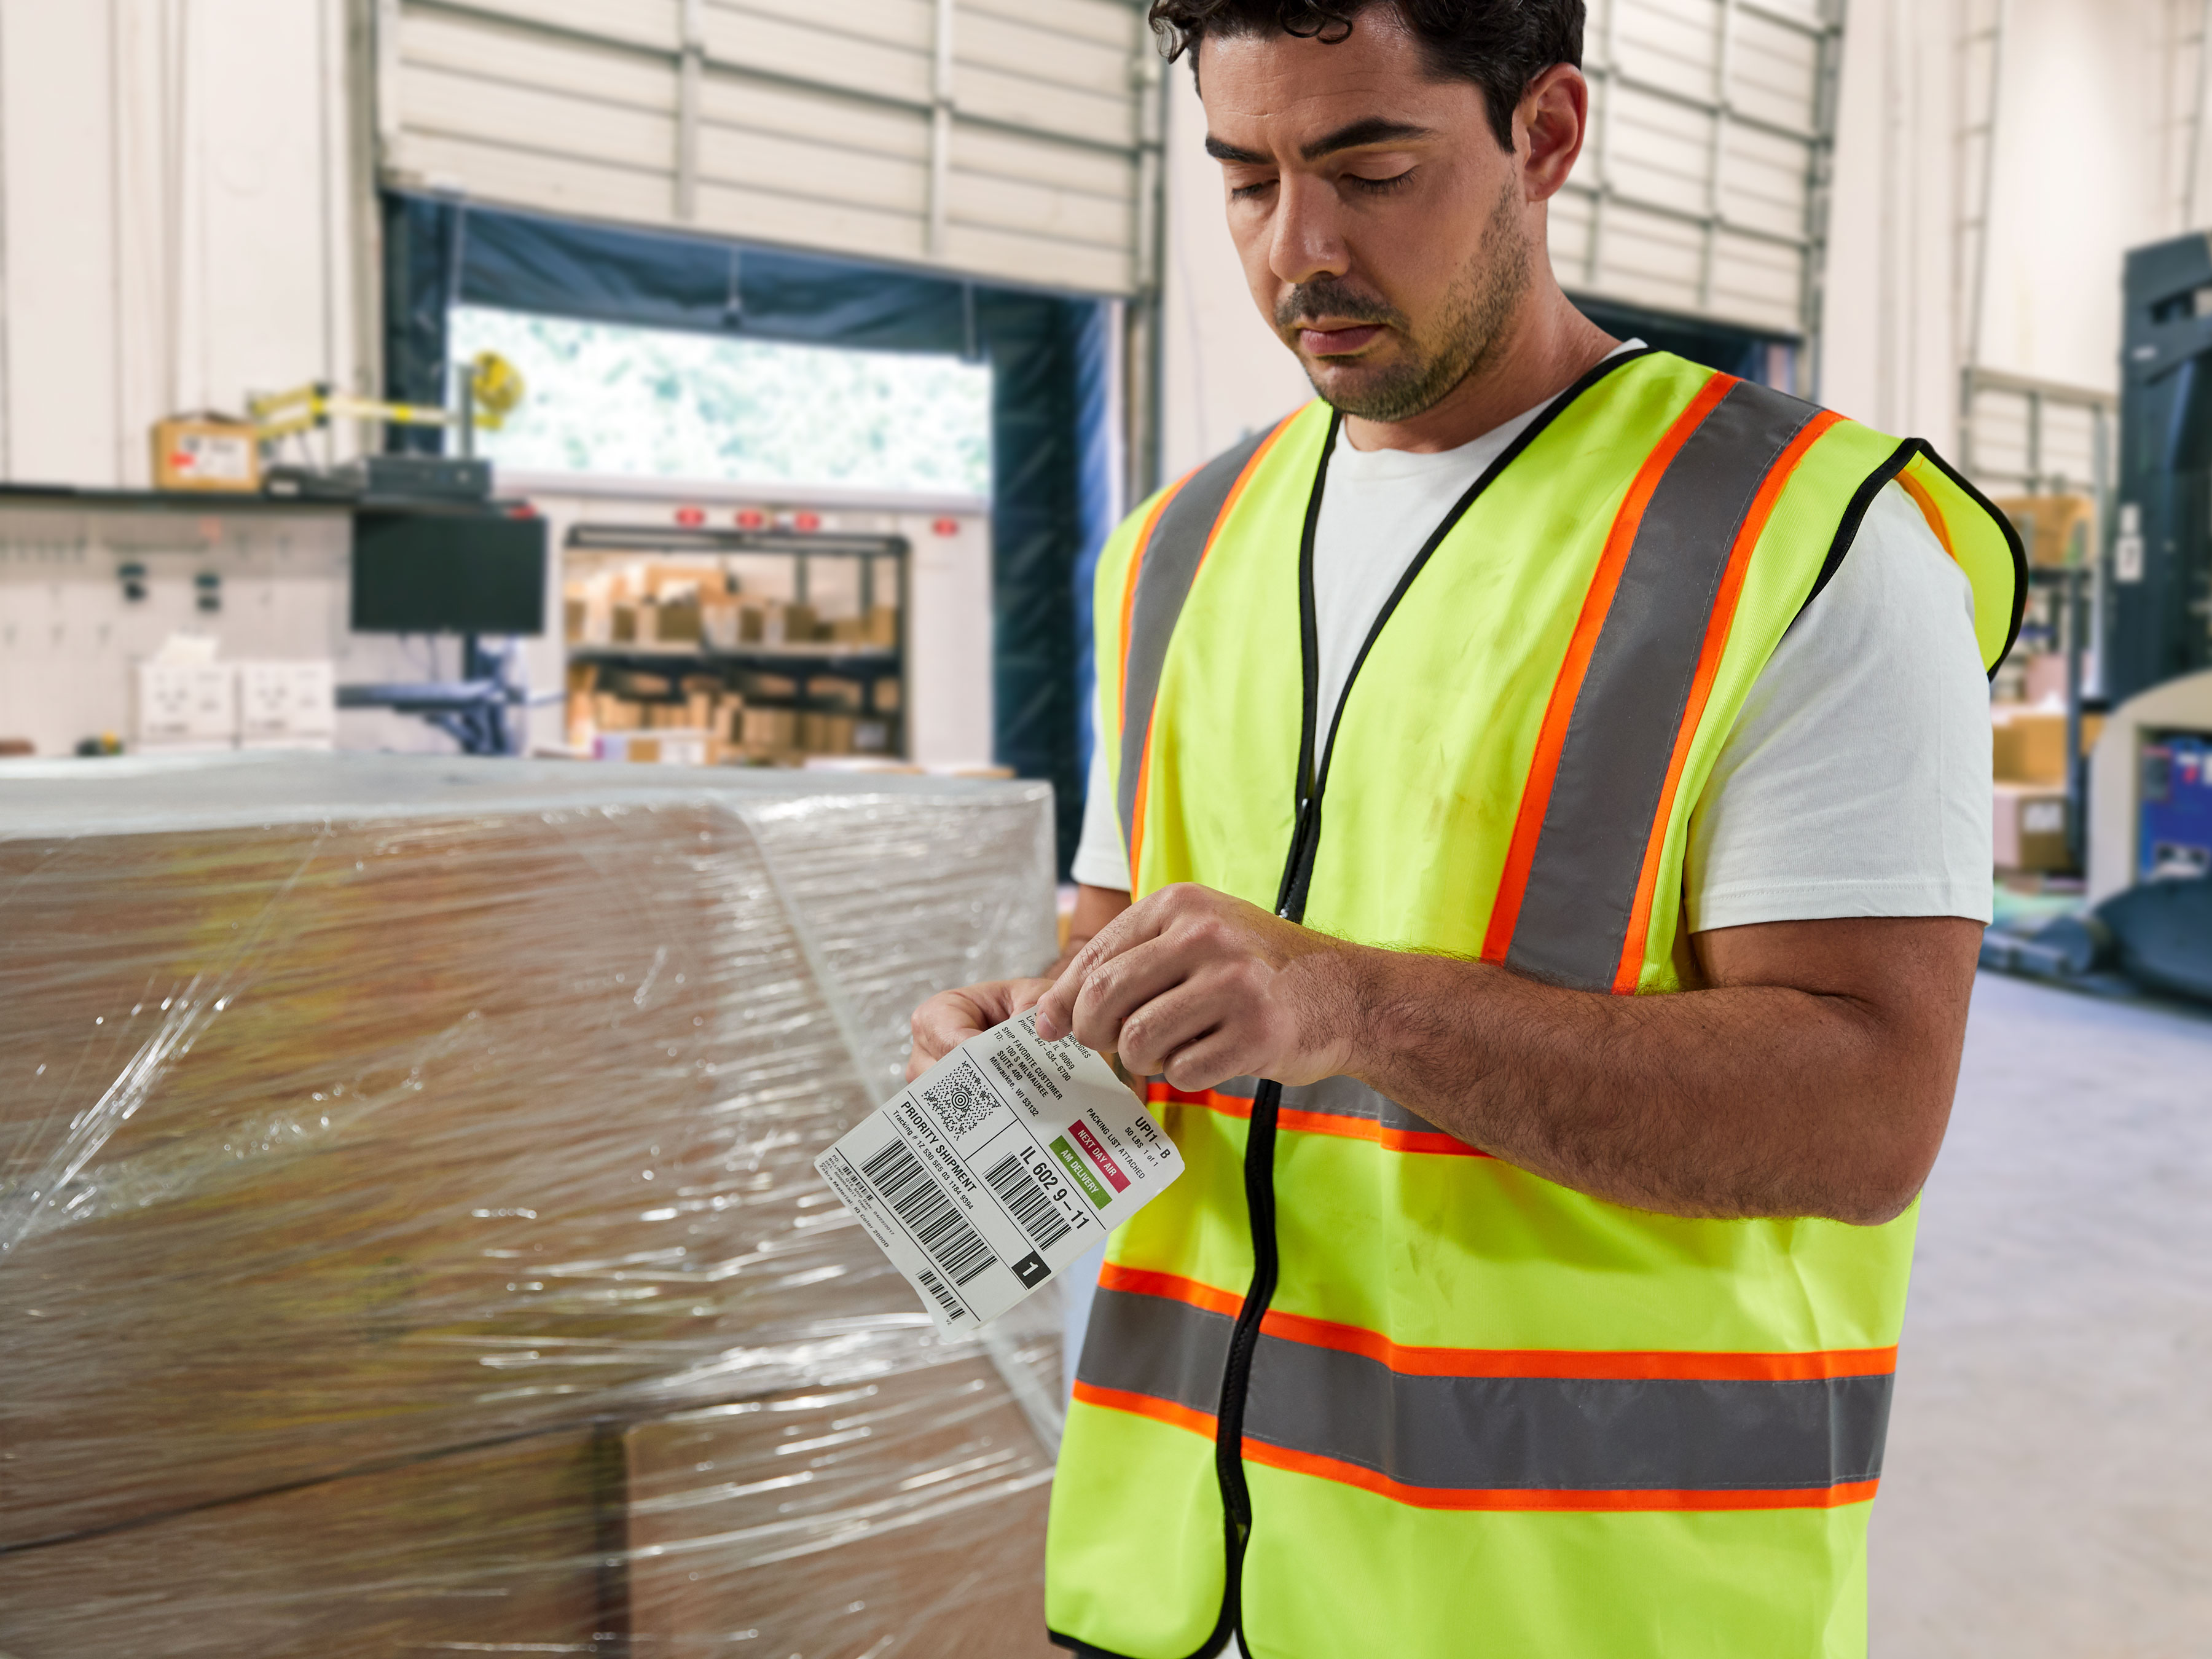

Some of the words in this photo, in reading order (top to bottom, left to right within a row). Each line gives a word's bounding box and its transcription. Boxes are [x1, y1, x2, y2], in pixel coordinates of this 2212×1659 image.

[1018, 1019, 1036, 1037] PHONE:
[1059, 1036, 1070, 1048] oint
[994, 1030, 1003, 1041] TO:
[1005, 1045, 1016, 1057] 100
[1018, 1061, 1048, 1097] MILWAUKEE
[997, 1050, 1013, 1069] SUITE
[1011, 1069, 1022, 1080] 400
[1002, 1027, 1015, 1038] SHIP
[1013, 1039, 1037, 1068] FAVORITE
[1034, 1067, 1062, 1100] CUSTOMER
[1059, 1052, 1075, 1070] 60069
[989, 1056, 1014, 1089] Milwaukee,
[1015, 1088, 1024, 1098] WI
[1022, 1097, 1038, 1116] 53132
[893, 1110, 913, 1135] Tracking
[917, 1140, 925, 1148] 1Z
[923, 1148, 934, 1160] 530
[932, 1159, 943, 1172] 5E5
[941, 1171, 950, 1180] 03
[949, 1180, 962, 1194] 1184
[960, 1194, 973, 1209] 9394
[1077, 1129, 1096, 1148] NEXT
[1092, 1147, 1107, 1163] DAY
[1103, 1163, 1116, 1176] AIR
[1086, 1107, 1109, 1135] PACKING
[1107, 1133, 1121, 1148] LIST
[1118, 1148, 1145, 1179] ATTACHED
[1124, 1126, 1134, 1136] 50
[1131, 1135, 1143, 1148] LBS
[900, 1100, 939, 1143] PRIORITY
[935, 1144, 976, 1191] SHIPMENT
[1022, 1261, 1038, 1276] 1
[1019, 1145, 1036, 1165] IL
[1032, 1162, 1058, 1190] 602
[1060, 1149, 1073, 1162] AM
[1070, 1160, 1099, 1193] DELIVERY
[818, 1164, 833, 1180] Zebra
[832, 1180, 853, 1206] Material:
[860, 1214, 873, 1228] Color
[853, 1187, 863, 1198] Ship
